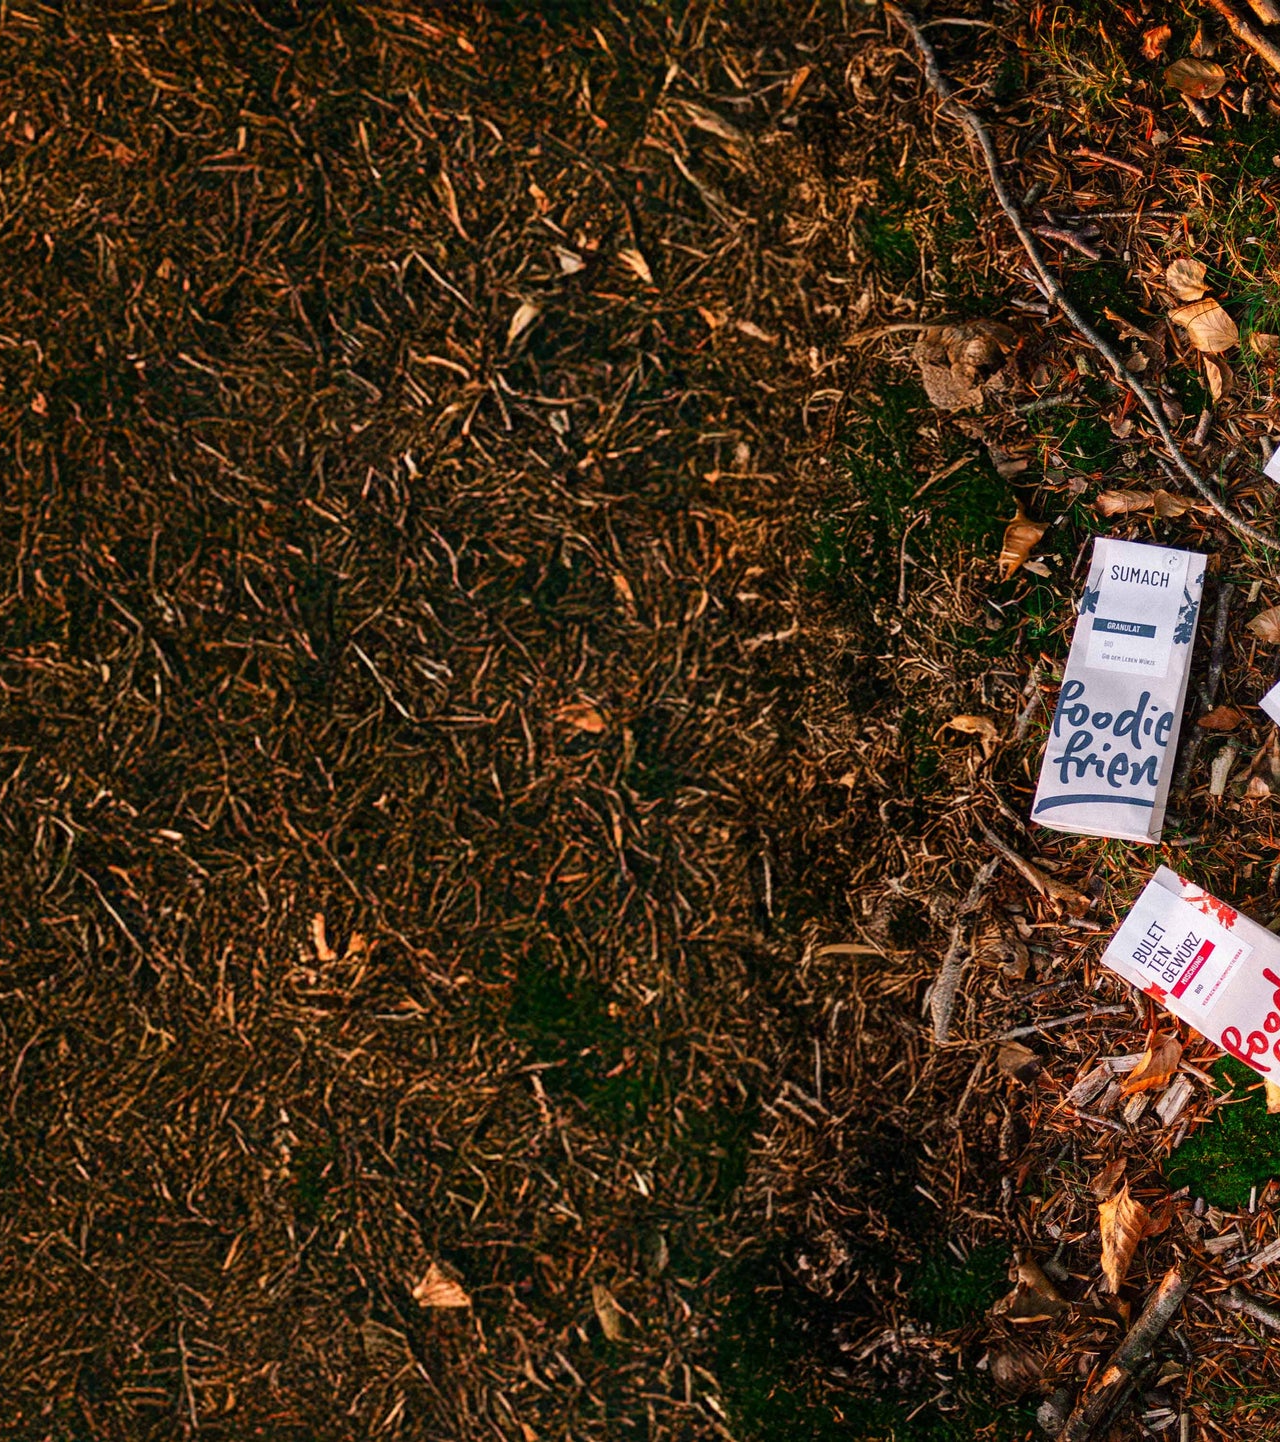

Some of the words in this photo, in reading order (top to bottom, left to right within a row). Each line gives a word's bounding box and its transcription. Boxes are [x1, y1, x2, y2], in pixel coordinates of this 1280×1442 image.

[1111, 565, 1169, 587] SUMACH
[1106, 621, 1140, 632] GRANULAT
[1053, 679, 1174, 750] foodie
[1132, 921, 1165, 964] BULET
[1162, 932, 1201, 983] GEWÜRZ
[1147, 946, 1172, 972] TEN
[1180, 954, 1204, 984] MISCHUNG
